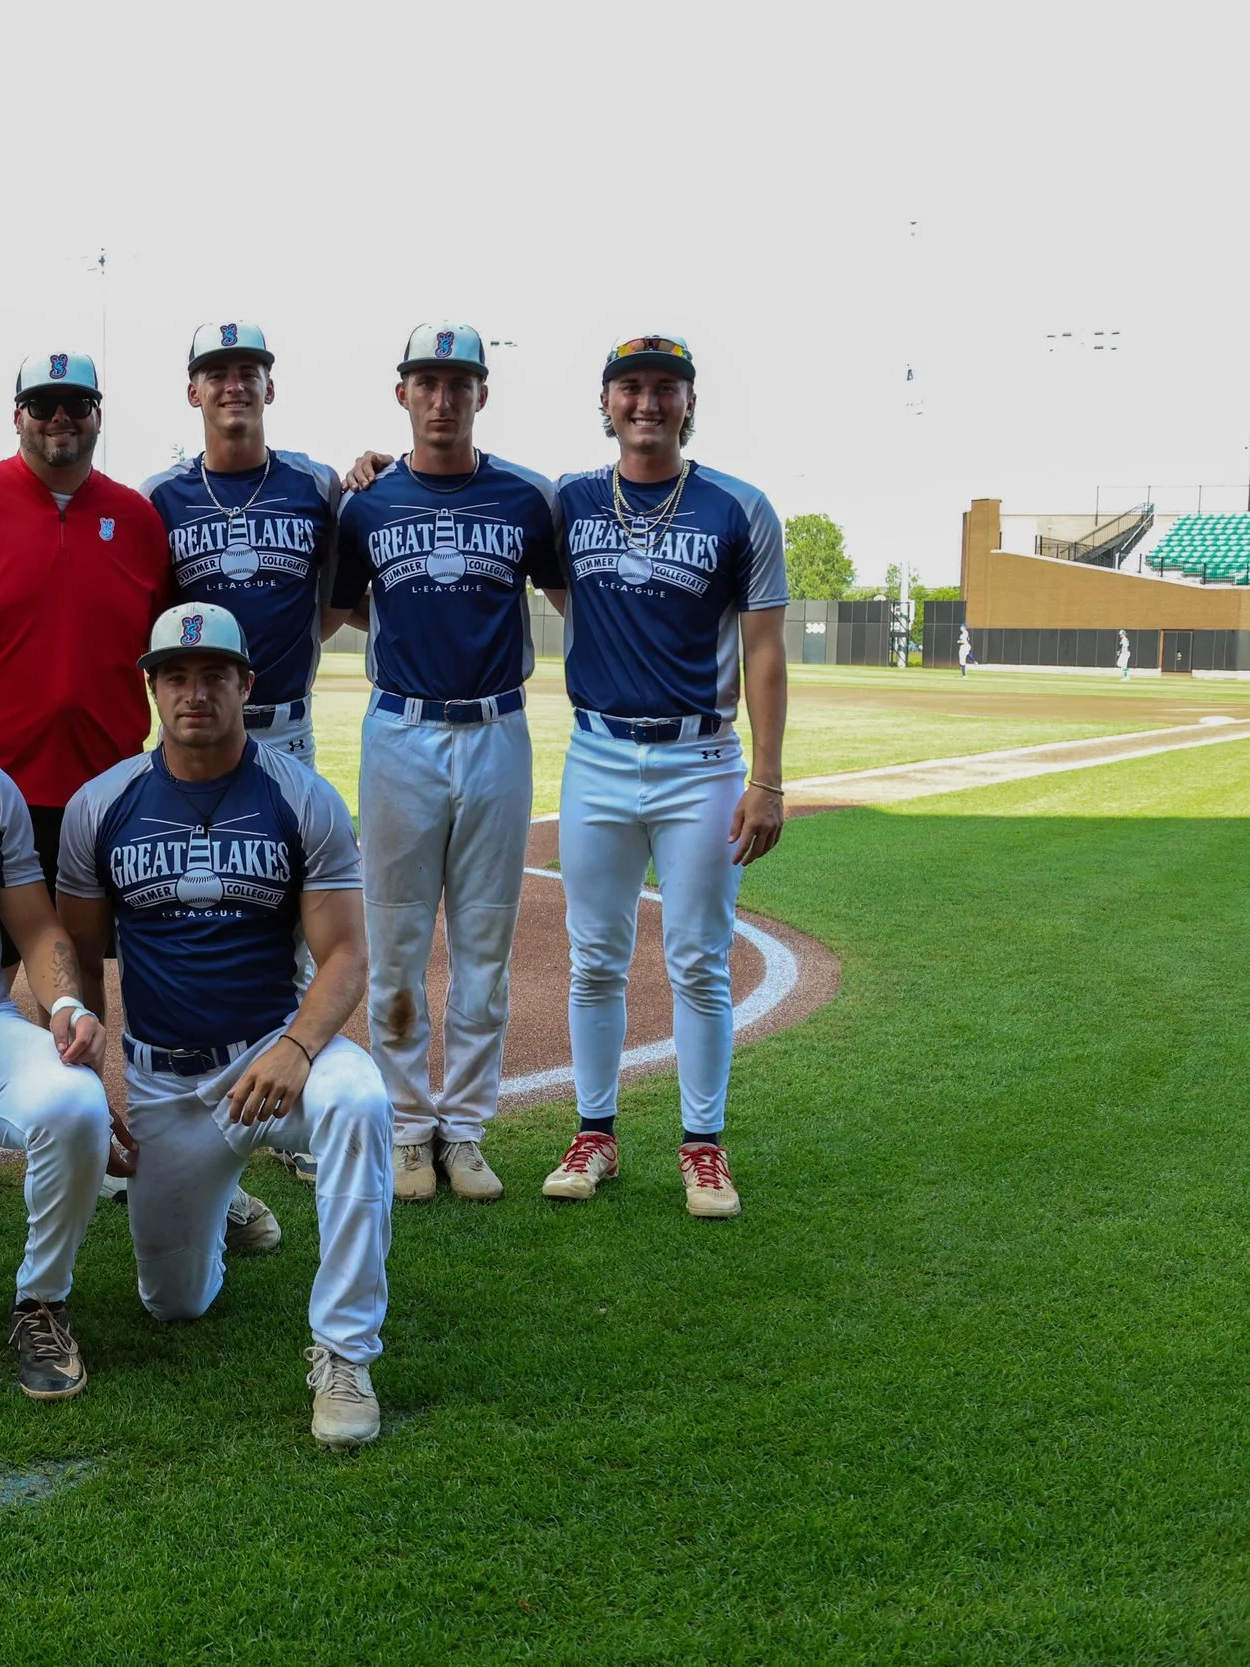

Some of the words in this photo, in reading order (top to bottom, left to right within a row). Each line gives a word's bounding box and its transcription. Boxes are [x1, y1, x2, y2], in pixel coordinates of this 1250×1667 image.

[248, 518, 315, 555] LAKES
[368, 523, 434, 569] GREAT
[456, 523, 524, 563] LAKES
[648, 531, 718, 573] LAKES
[178, 559, 216, 584] SUMMER
[384, 562, 423, 585] SUMMER
[576, 558, 614, 574] SUMMER
[655, 566, 707, 592] COLLEGIATE
[110, 842, 186, 889] GREAT
[212, 840, 291, 883] LAKES
[128, 886, 172, 906] UMMER
